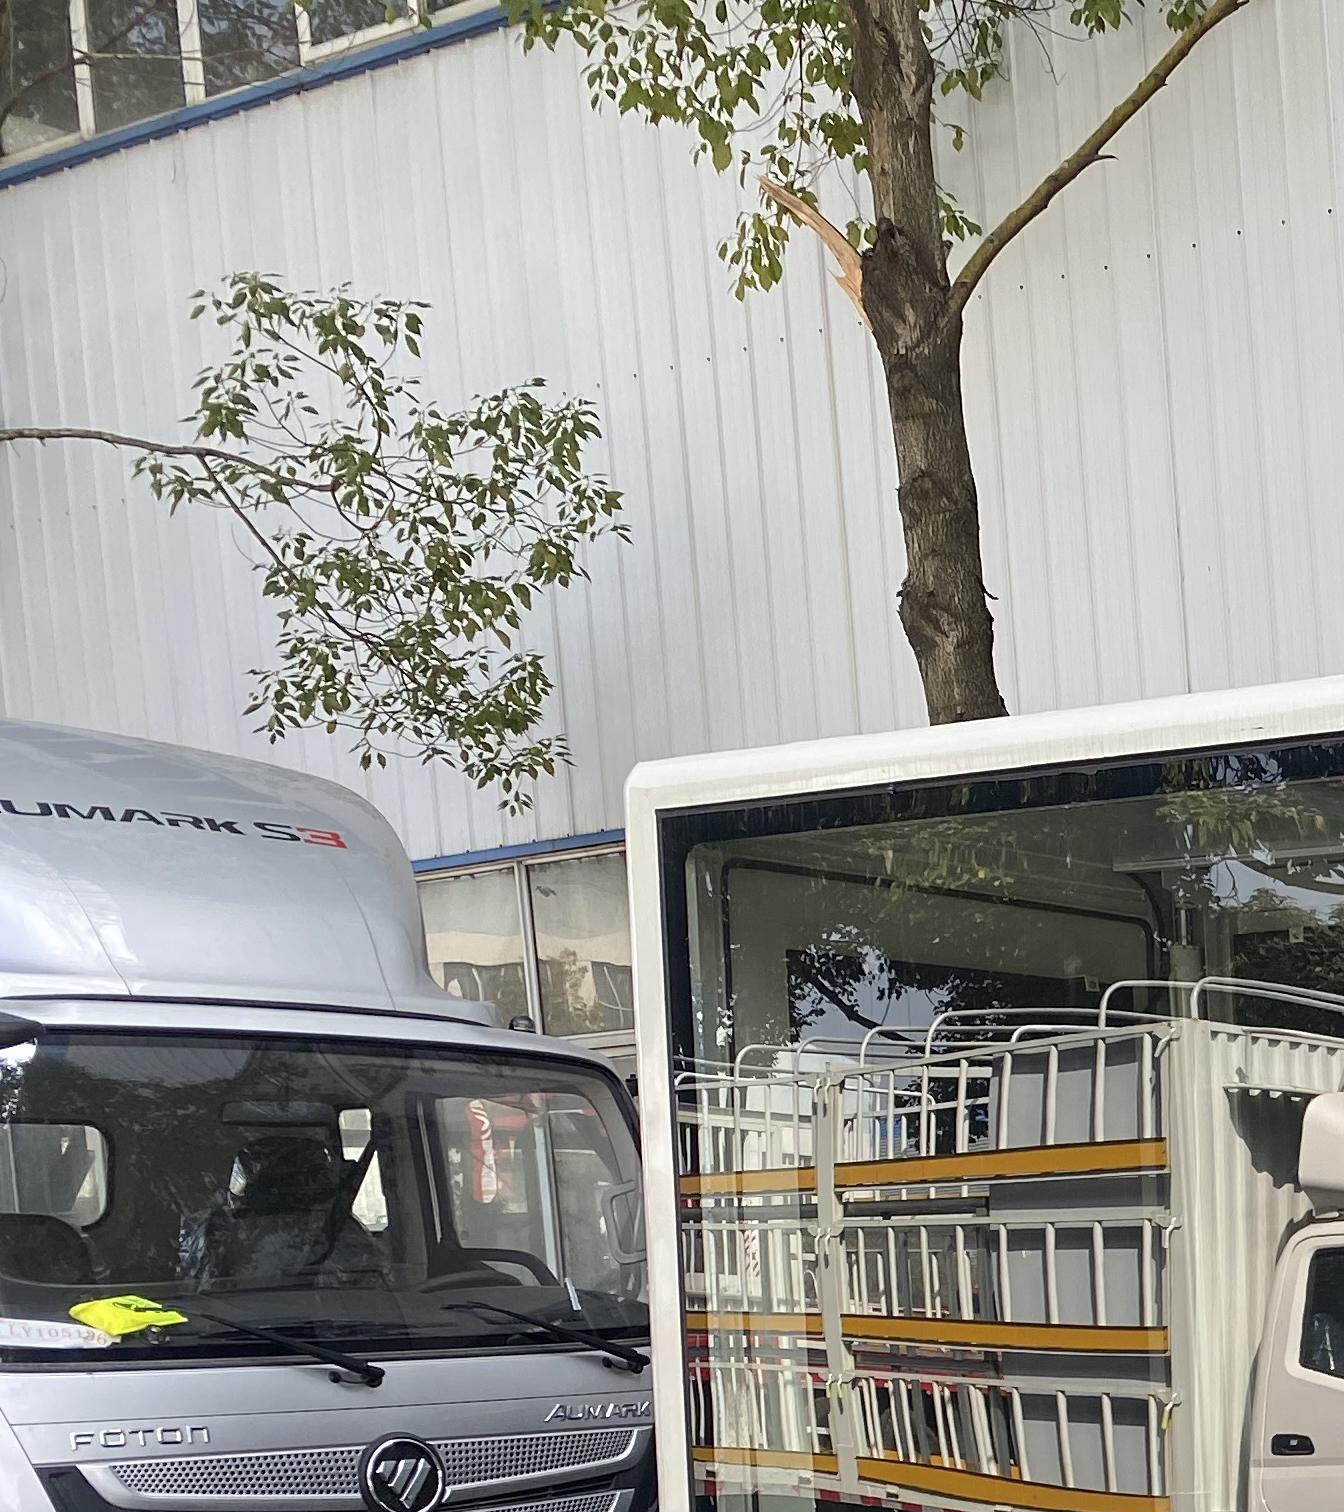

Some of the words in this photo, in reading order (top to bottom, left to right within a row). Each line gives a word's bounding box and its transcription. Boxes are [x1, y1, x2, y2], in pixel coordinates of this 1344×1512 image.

[0, 798, 247, 837] UMARK
[254, 820, 348, 849] S3
[543, 1400, 652, 1423] AUMARK
[69, 1425, 210, 1451] FOTON
